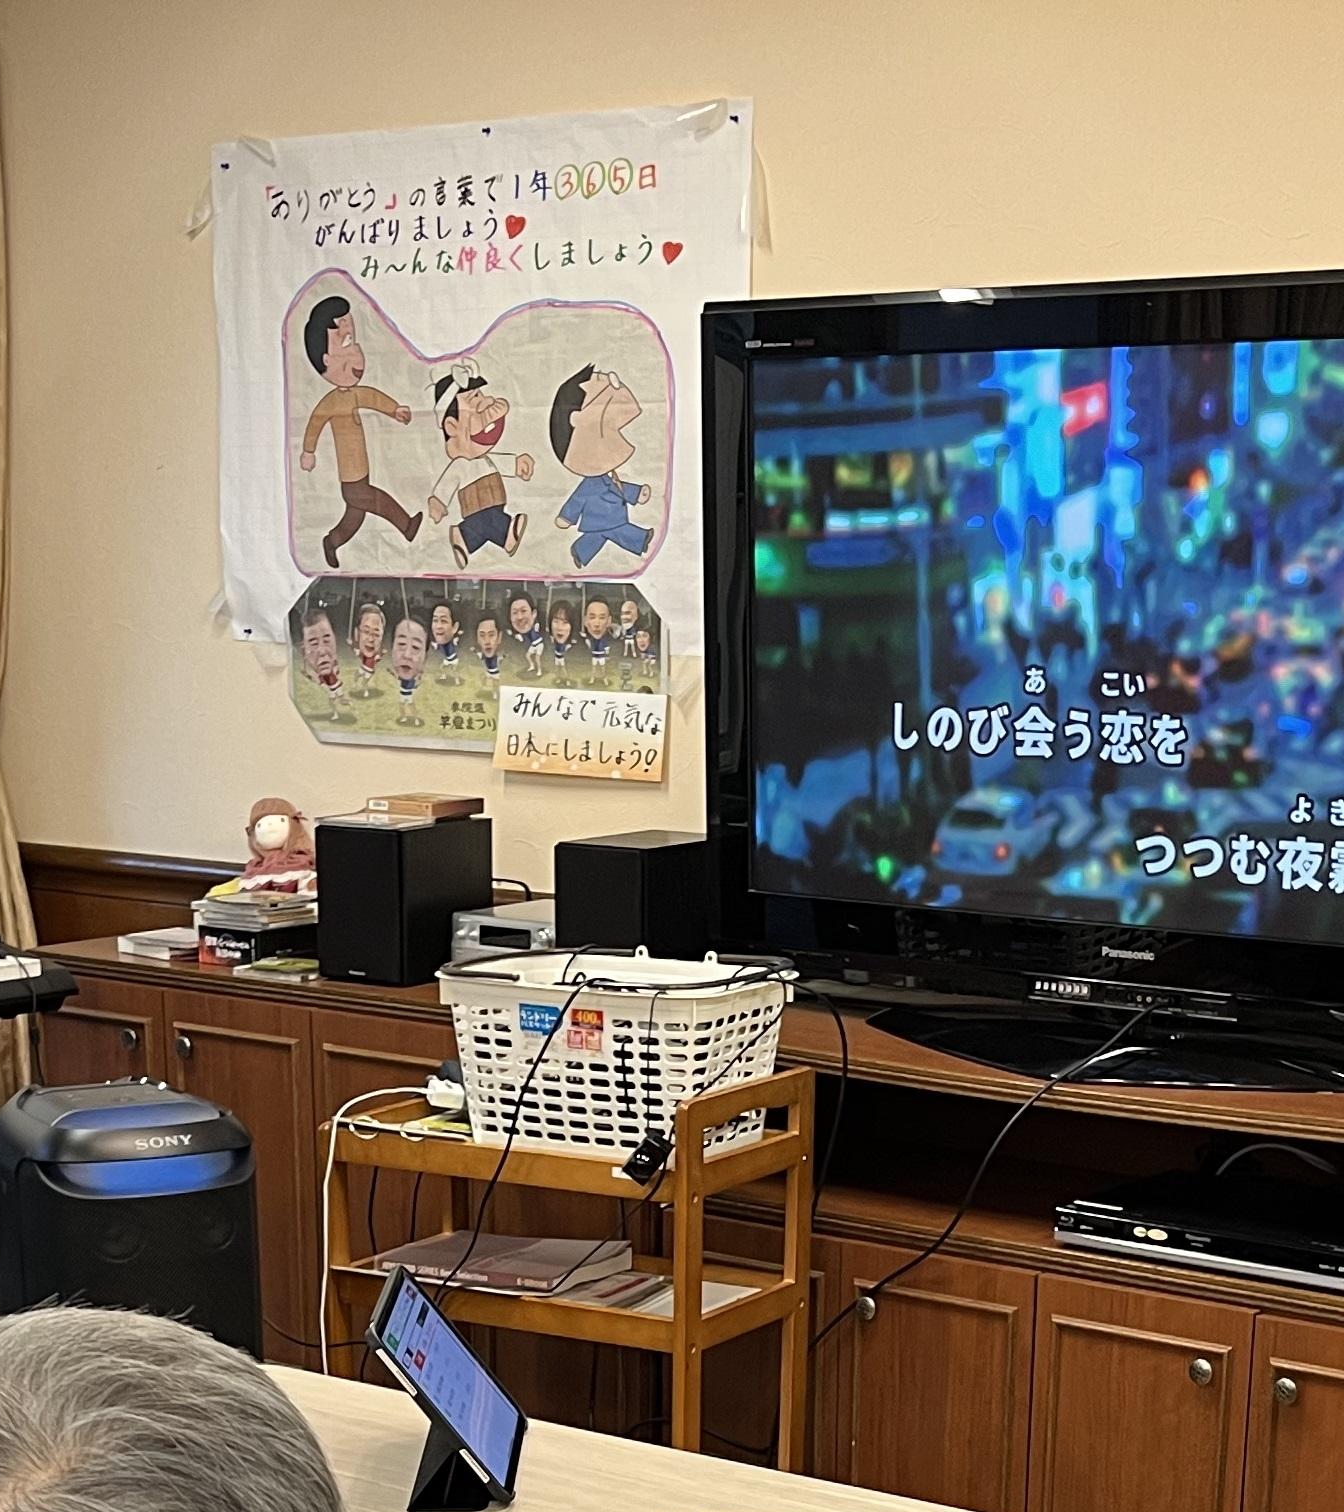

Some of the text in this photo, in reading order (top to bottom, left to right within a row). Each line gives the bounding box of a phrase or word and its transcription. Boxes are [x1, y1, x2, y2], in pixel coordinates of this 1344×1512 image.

[314, 208, 501, 249] がんばりましょう
[1024, 667, 1146, 698] あ こい
[513, 691, 663, 736] みんなで元気な
[893, 701, 1188, 766] しのび会う恋を
[1290, 796, 1313, 824] よ
[1101, 945, 1155, 961] Panasonic
[134, 1133, 193, 1150] SONY
